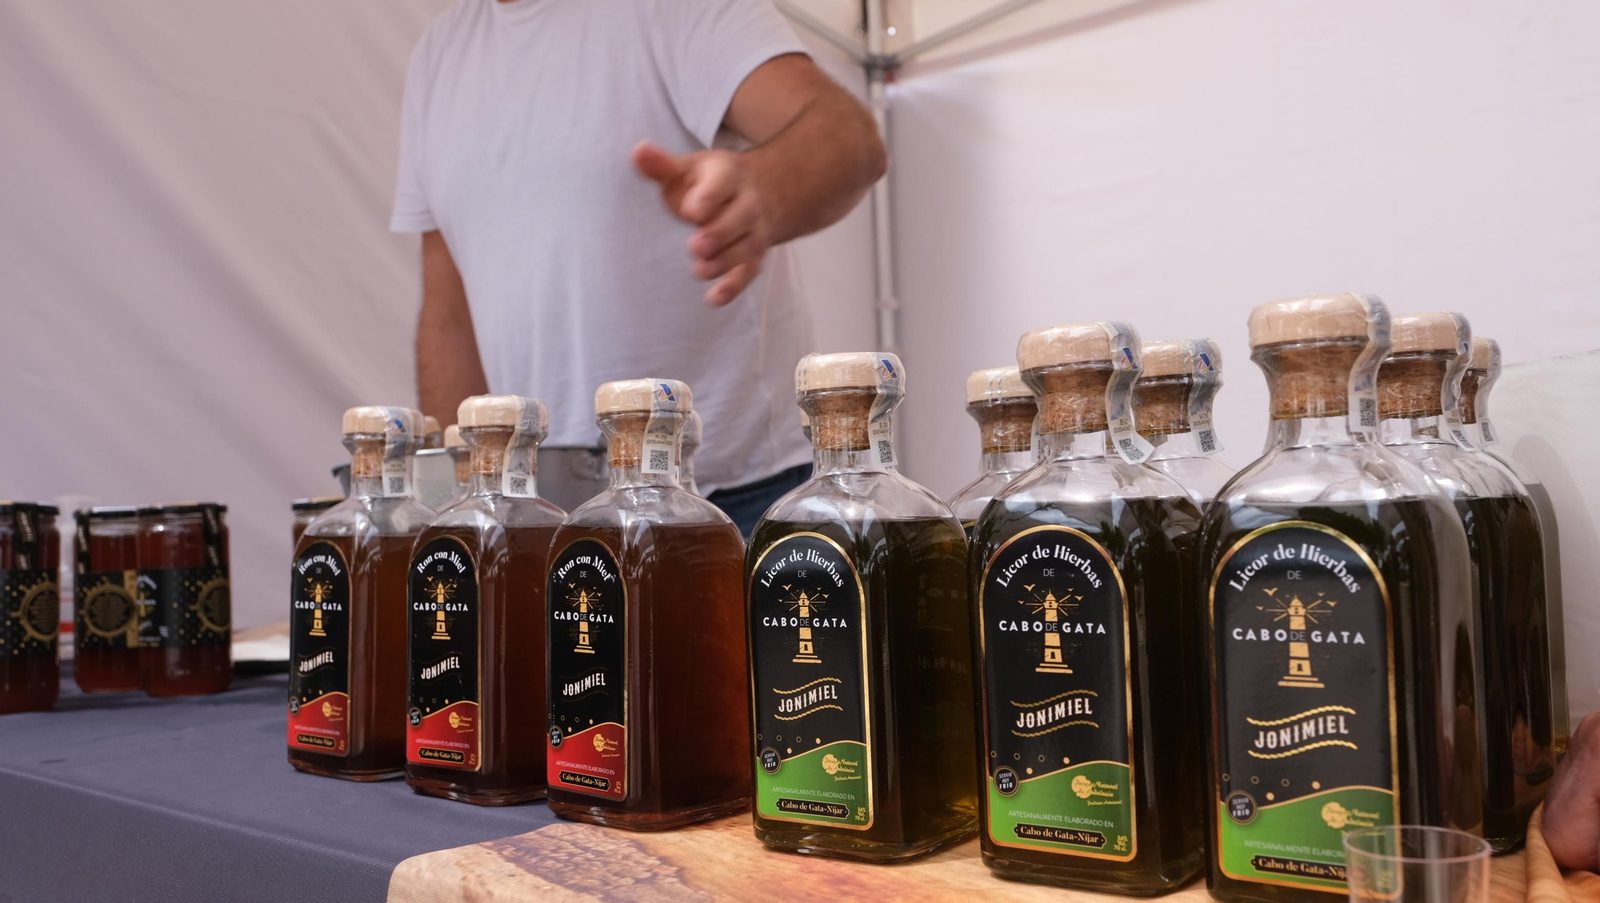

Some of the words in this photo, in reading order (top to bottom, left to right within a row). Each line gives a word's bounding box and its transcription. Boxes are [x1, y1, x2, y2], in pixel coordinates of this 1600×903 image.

[299, 558, 312, 575] Ron
[326, 555, 340, 576] Miel
[417, 555, 432, 574] Ron
[434, 551, 448, 559] con
[449, 551, 466, 573] Miel
[558, 559, 575, 579] Ron
[576, 556, 591, 564] con
[592, 556, 612, 581] Miel
[761, 557, 786, 588] Licor
[789, 549, 803, 562] de
[806, 549, 844, 588] Hierbas
[996, 554, 1028, 588] Licor
[1032, 545, 1050, 560] de
[1054, 544, 1102, 588] Hierbas
[1229, 554, 1268, 592] Licor
[1273, 544, 1295, 560] de
[1300, 543, 1361, 593] Hierbas
[1287, 571, 1301, 580] DE
[295, 601, 315, 609] CABO
[322, 602, 342, 611] GATA
[414, 602, 436, 611] CABO
[446, 603, 468, 611] GATA
[554, 611, 579, 620] CABO
[589, 613, 614, 623] GATA
[763, 617, 798, 627] CABO
[813, 618, 847, 628] GATA
[999, 620, 1043, 632] CABO
[1045, 623, 1058, 632] DE
[1062, 623, 1106, 634] GATA
[1232, 628, 1287, 642] CABO
[1290, 631, 1306, 641] DE
[1311, 631, 1365, 644] GATA
[299, 651, 334, 672] JONIMIEL
[421, 657, 460, 679] JONIMIEL
[562, 673, 606, 696] JONIMIEL
[778, 685, 838, 712] JONIMIEL
[1016, 698, 1092, 728] JONIMIEL
[1254, 715, 1349, 749] JONIMIEL
[772, 786, 816, 797] ARTESANALMENTE
[816, 790, 847, 800] ELABORADO
[781, 801, 798, 809] Cabo
[1008, 810, 1063, 822] ARTESANALMENTE
[1064, 816, 1103, 827] ELABORADO
[1020, 826, 1041, 836] Cabo
[1043, 828, 1053, 837] de
[1244, 839, 1310, 854] ARTESANALMENTE
[1258, 858, 1284, 870] Cabo
[1286, 860, 1298, 871] de
